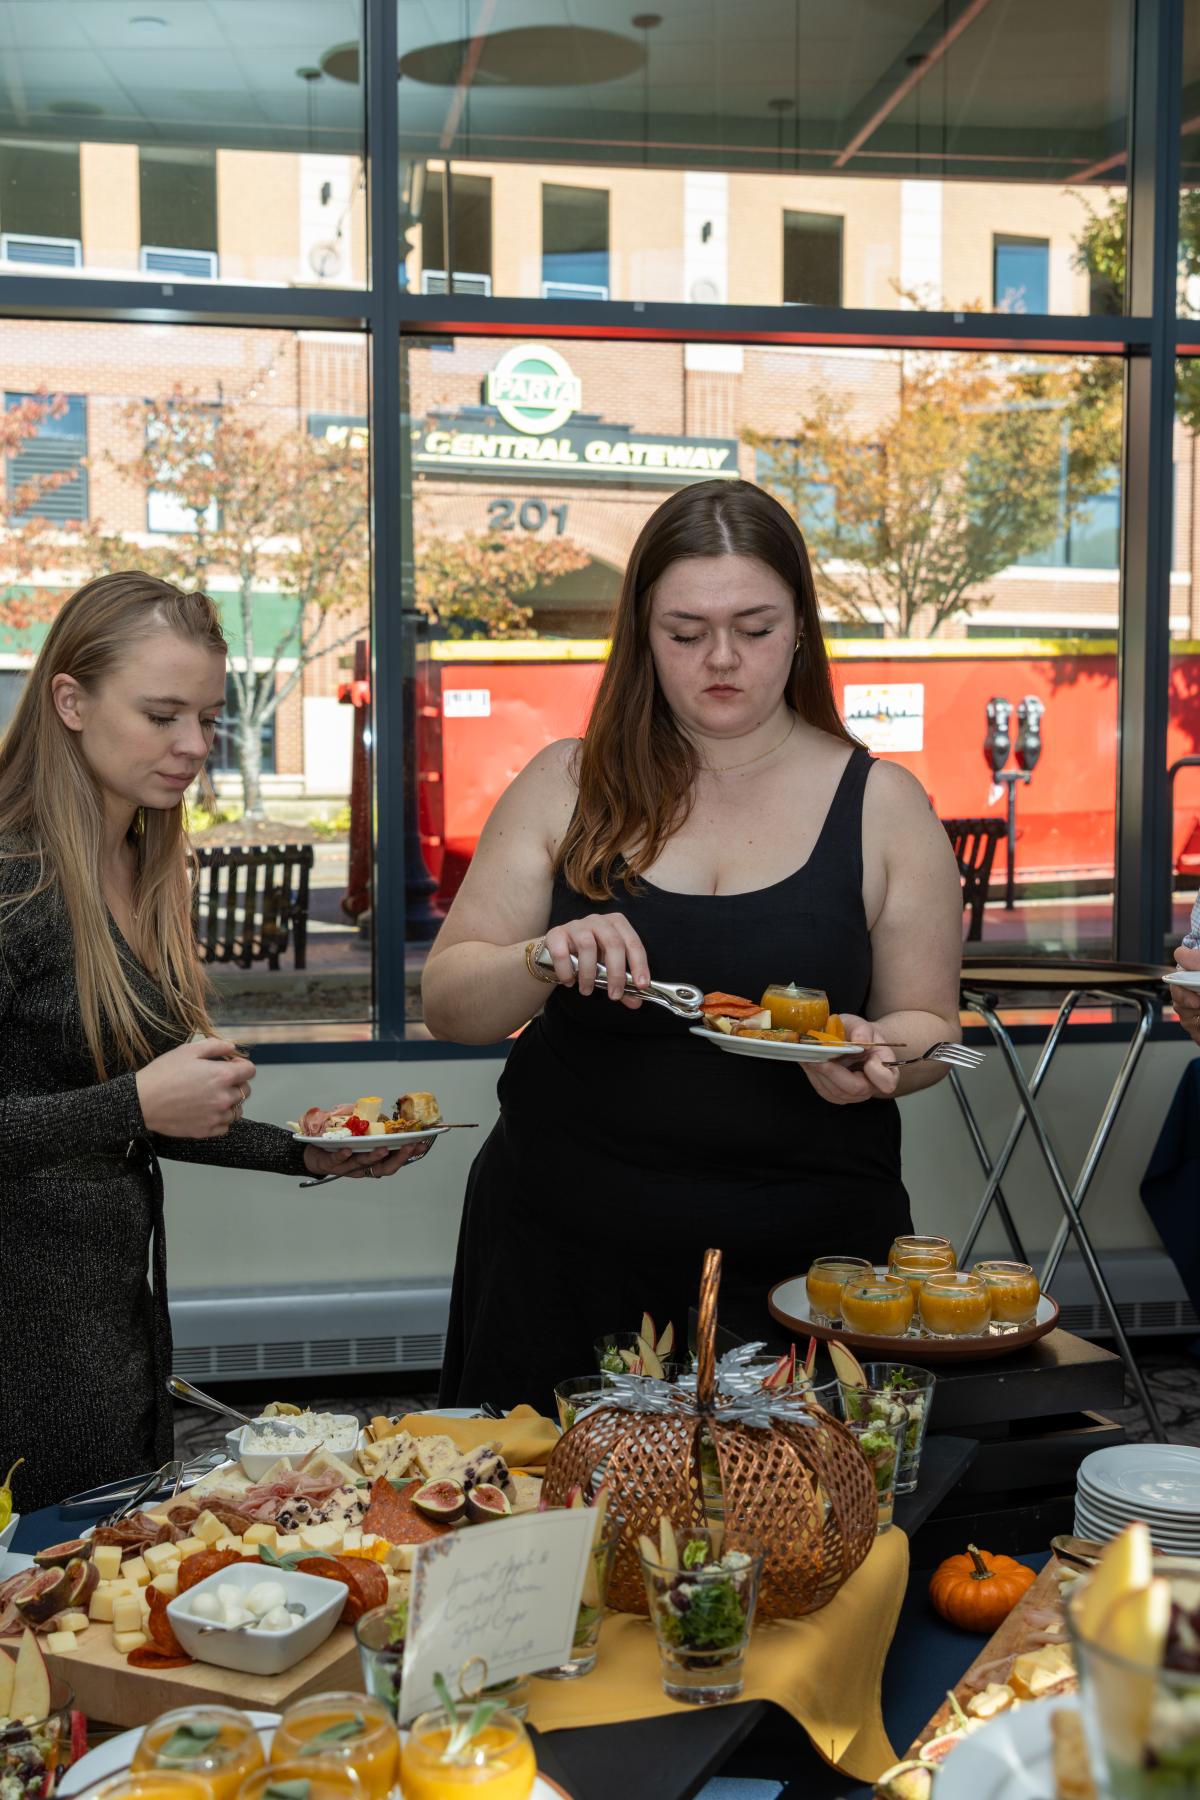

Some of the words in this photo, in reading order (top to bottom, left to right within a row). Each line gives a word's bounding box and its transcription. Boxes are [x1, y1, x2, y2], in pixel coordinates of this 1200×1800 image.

[494, 376, 577, 403] PARTA
[425, 431, 578, 462] CENTRAL
[585, 440, 730, 469] GATEWAY
[488, 499, 568, 535] 201
